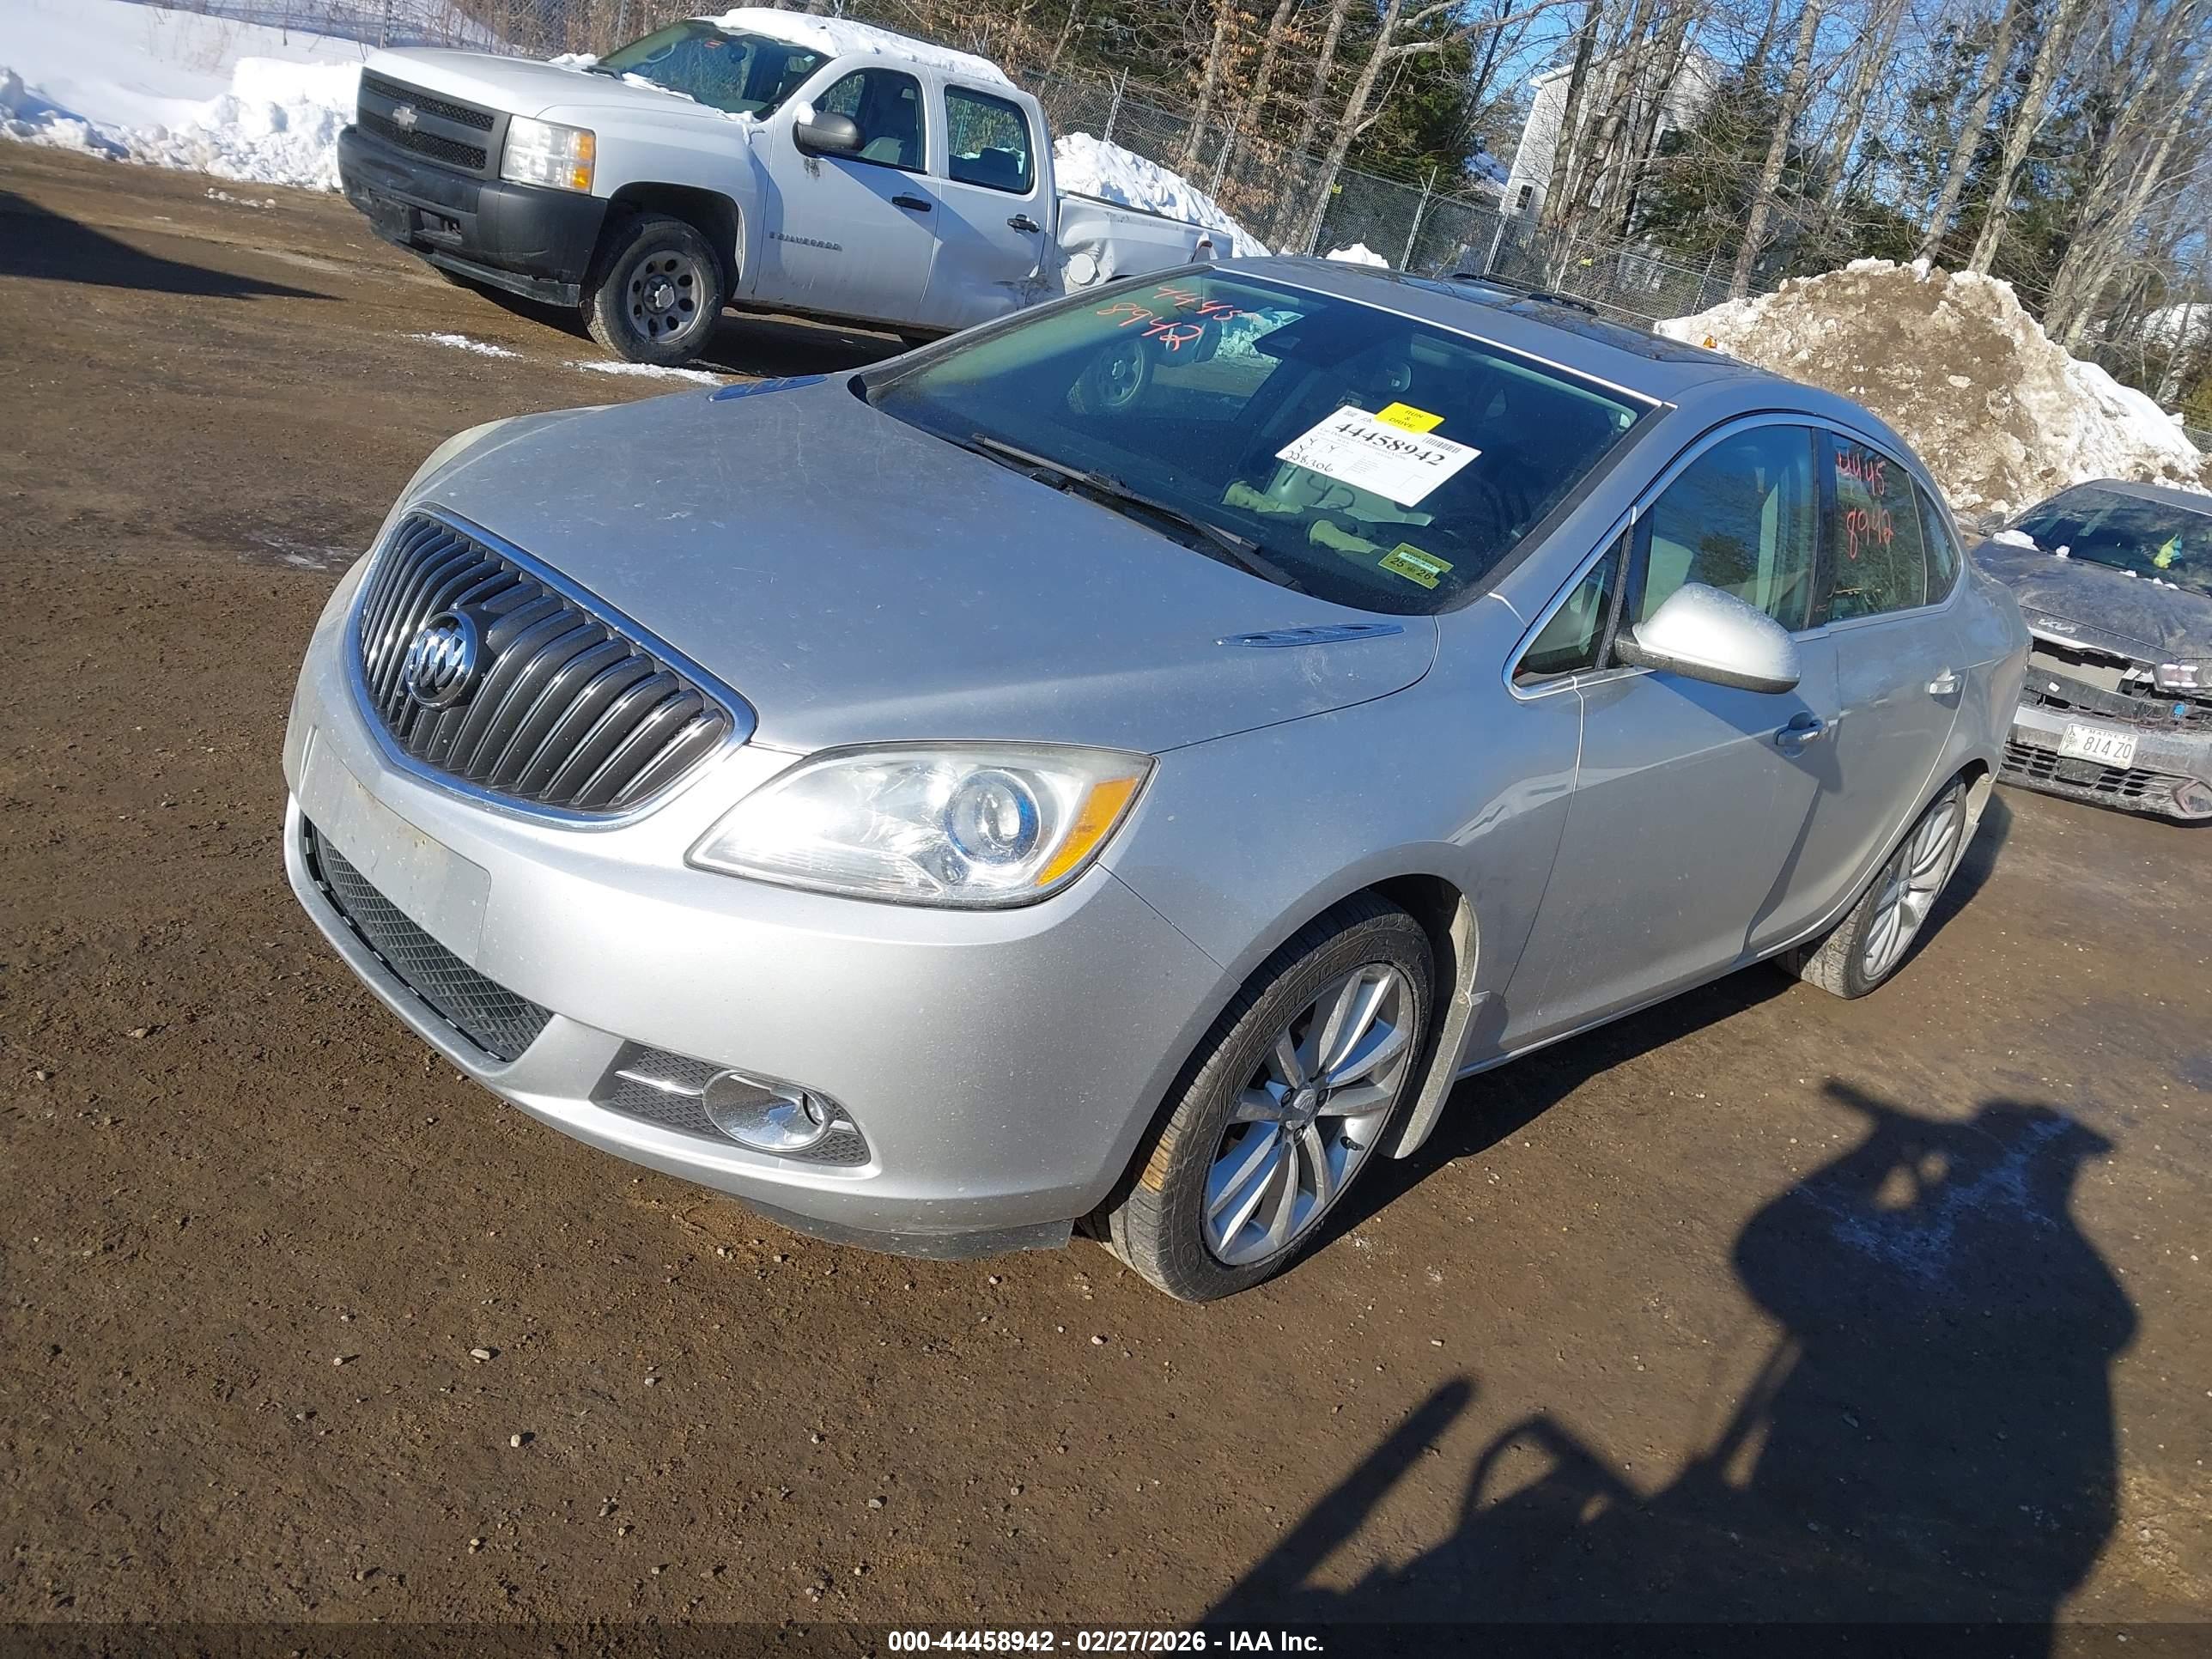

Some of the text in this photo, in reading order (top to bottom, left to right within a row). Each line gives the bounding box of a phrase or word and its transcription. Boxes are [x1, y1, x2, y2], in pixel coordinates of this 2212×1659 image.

[1405, 410, 1424, 418] RUN
[1389, 417, 1416, 428] DRIVE
[1334, 423, 1445, 466] 44458942
[2088, 729, 2119, 740] MAINE
[2083, 736, 2112, 756] 814
